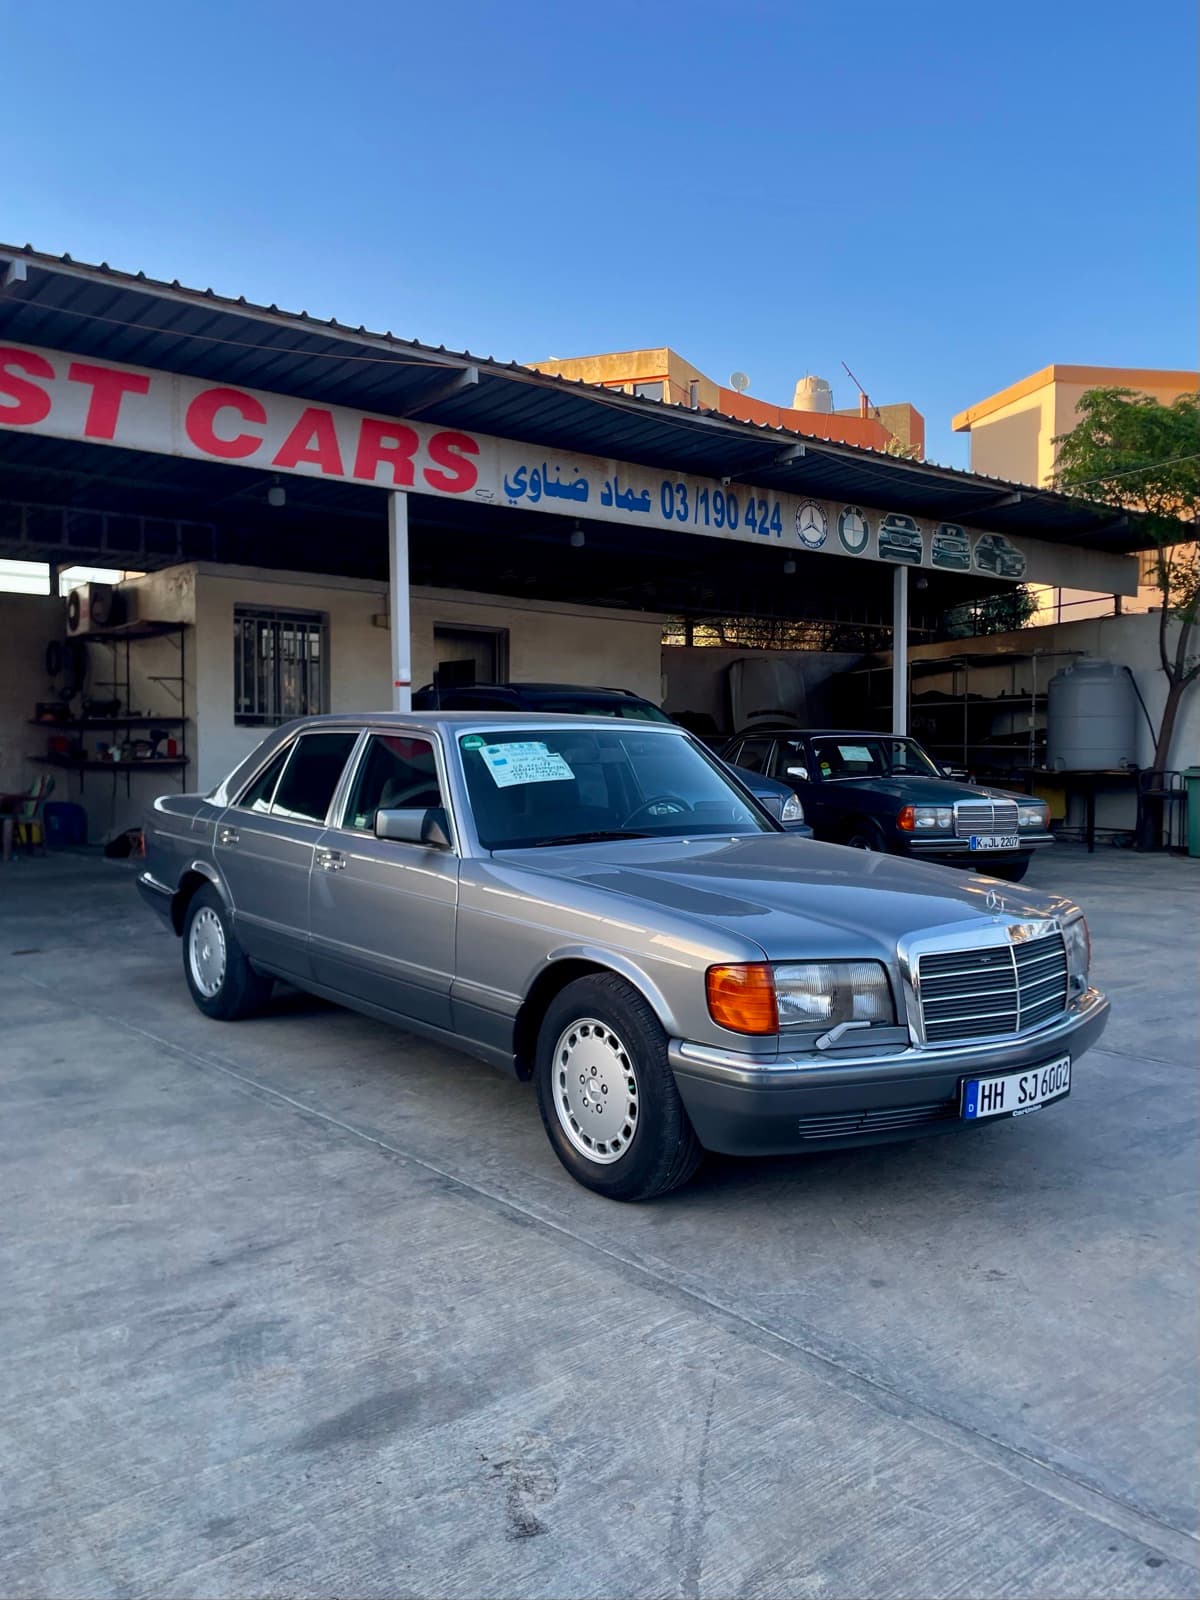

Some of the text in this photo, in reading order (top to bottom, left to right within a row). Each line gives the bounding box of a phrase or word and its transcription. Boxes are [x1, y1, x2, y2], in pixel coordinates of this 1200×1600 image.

[185, 387, 481, 494] CARS
[503, 462, 651, 513] عماد ضناوي
[661, 480, 739, 531] 03/190
[744, 496, 783, 538] 424
[968, 1103, 974, 1112] D
[980, 1081, 1005, 1112] HH
[1041, 1061, 1068, 1096] 6002
